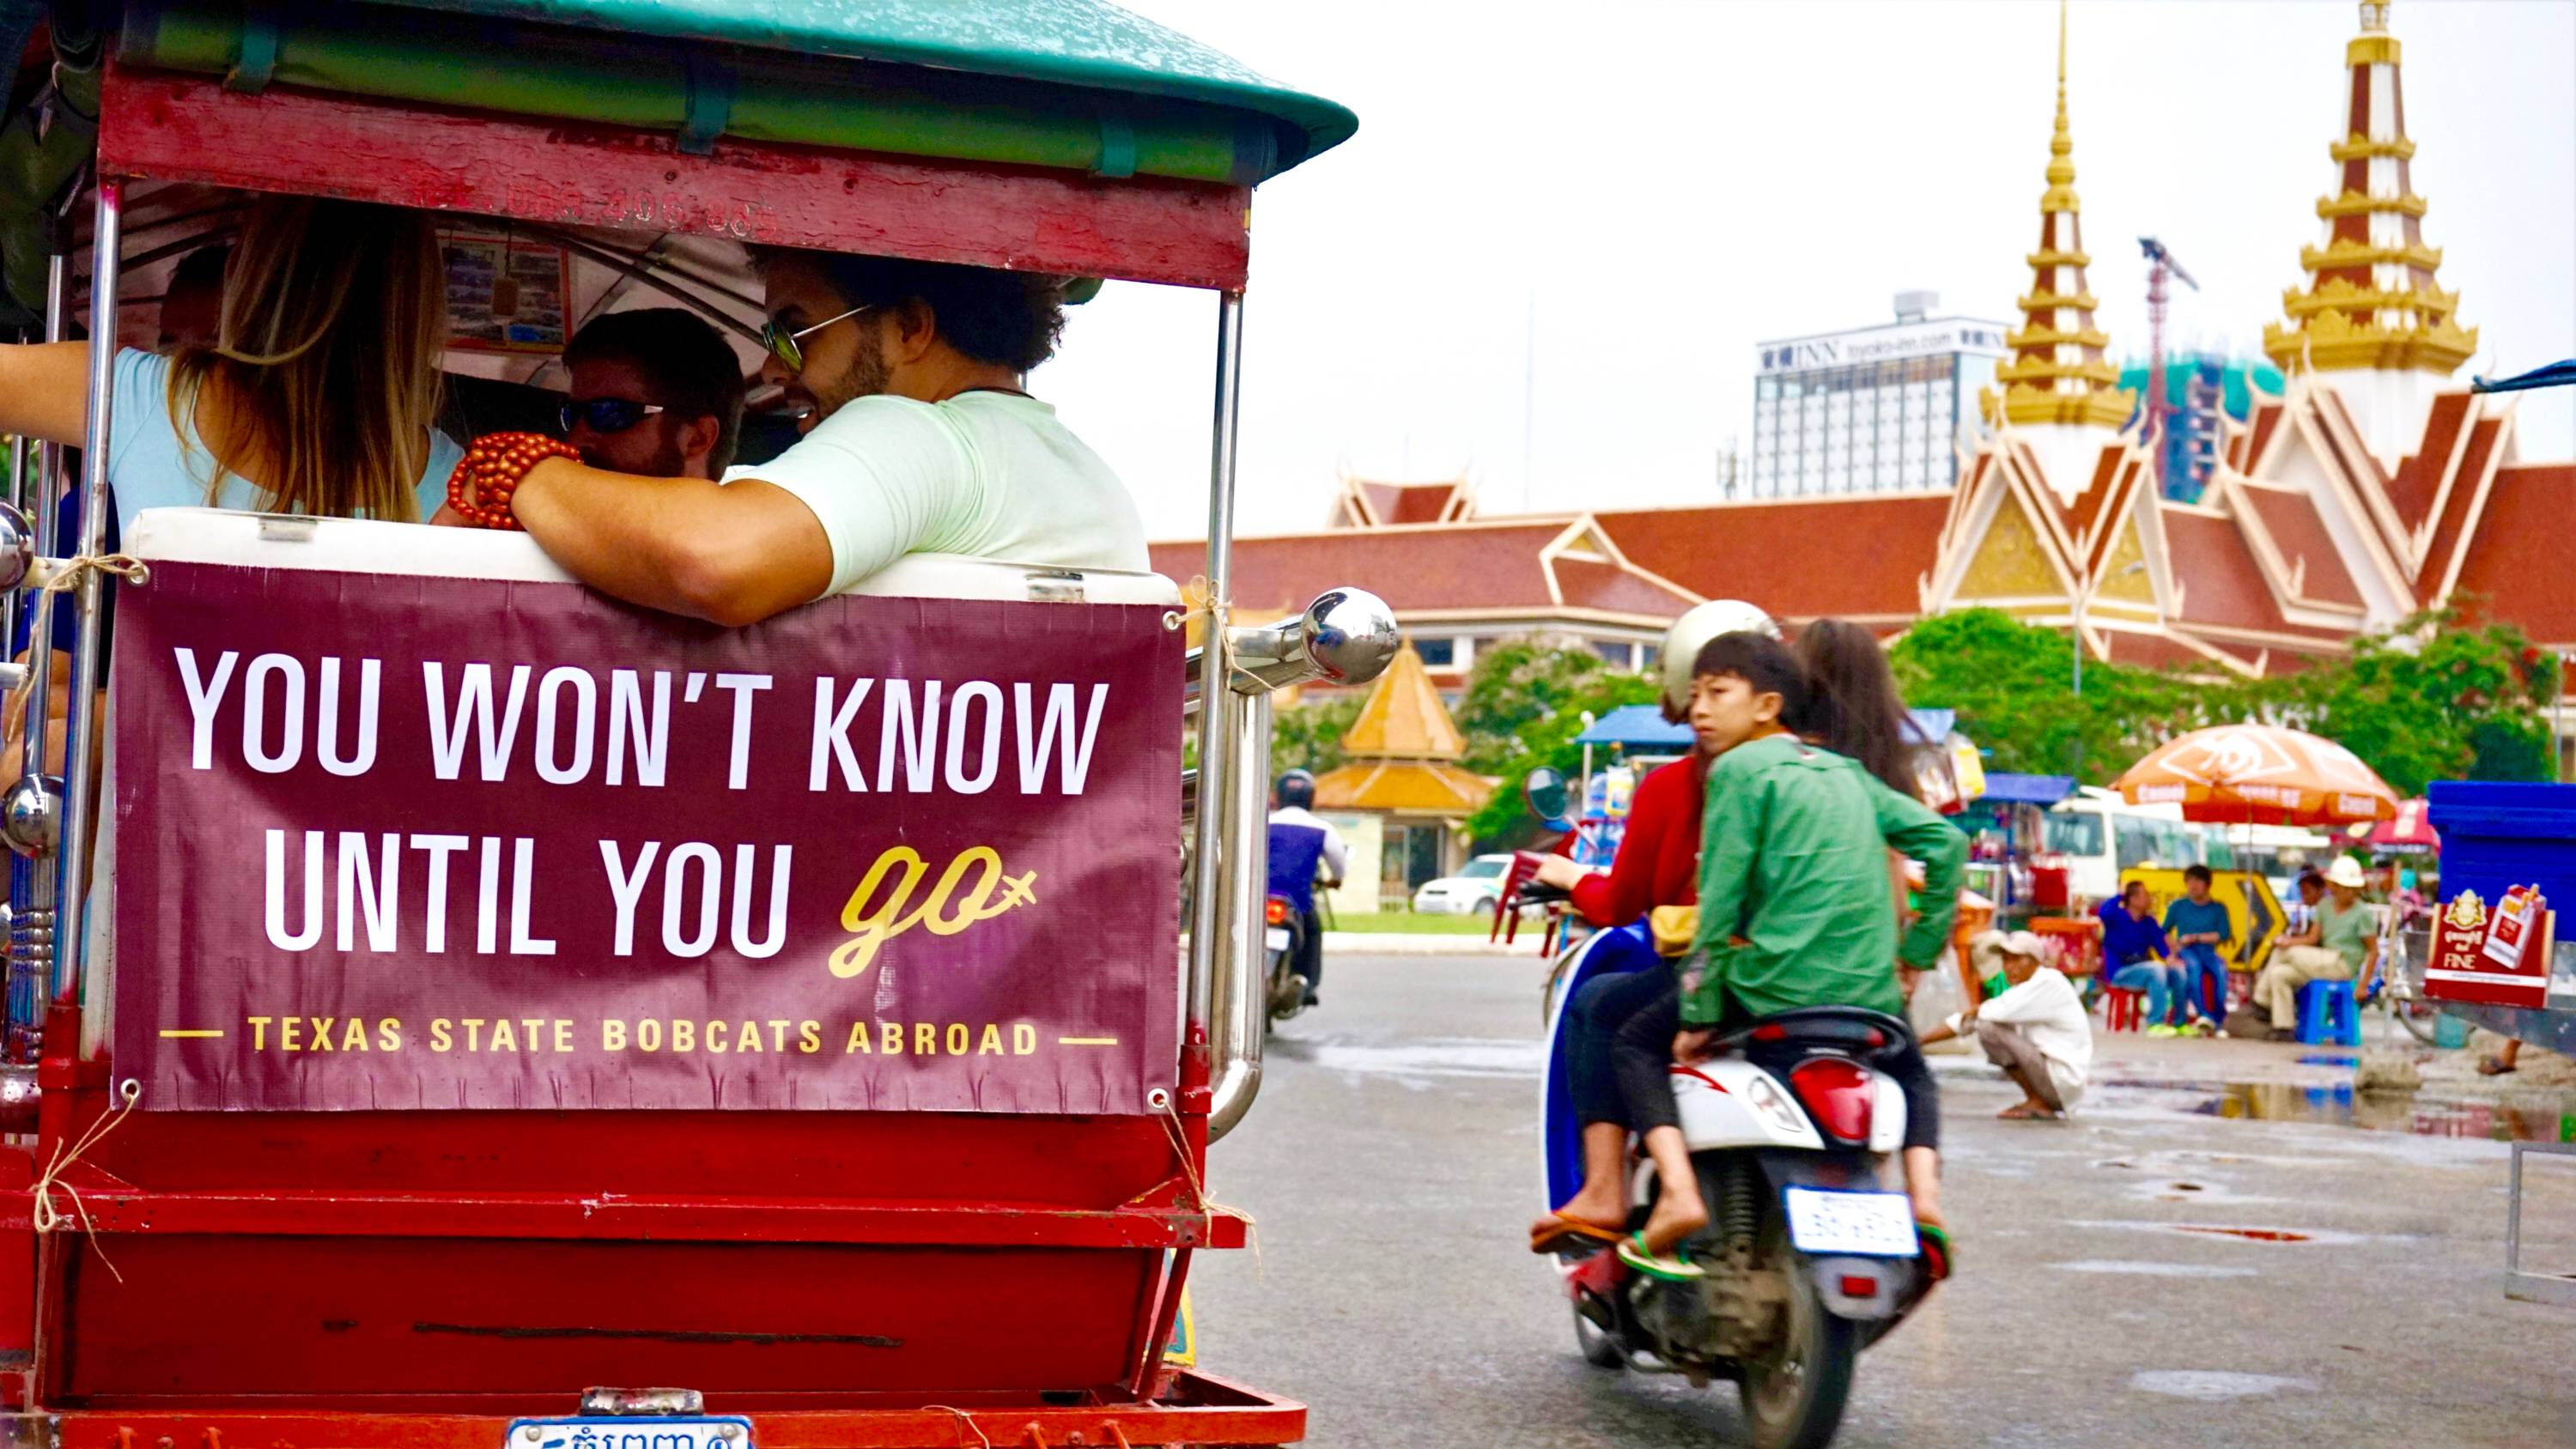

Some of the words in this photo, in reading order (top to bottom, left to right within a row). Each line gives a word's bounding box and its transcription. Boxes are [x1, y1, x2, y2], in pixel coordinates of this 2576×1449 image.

[173, 646, 382, 778] YOU
[422, 660, 774, 791] WON'T
[808, 676, 1110, 796] KNOW
[264, 828, 557, 956] UNTIL
[598, 839, 793, 960] YOU
[827, 845, 1015, 979] go
[2443, 953, 2477, 970] FINE
[246, 1016, 402, 1052] TEXAS
[429, 1017, 575, 1053] STATE
[602, 1018, 821, 1054] BOBCATS
[846, 1022, 1037, 1057] ABROAD
